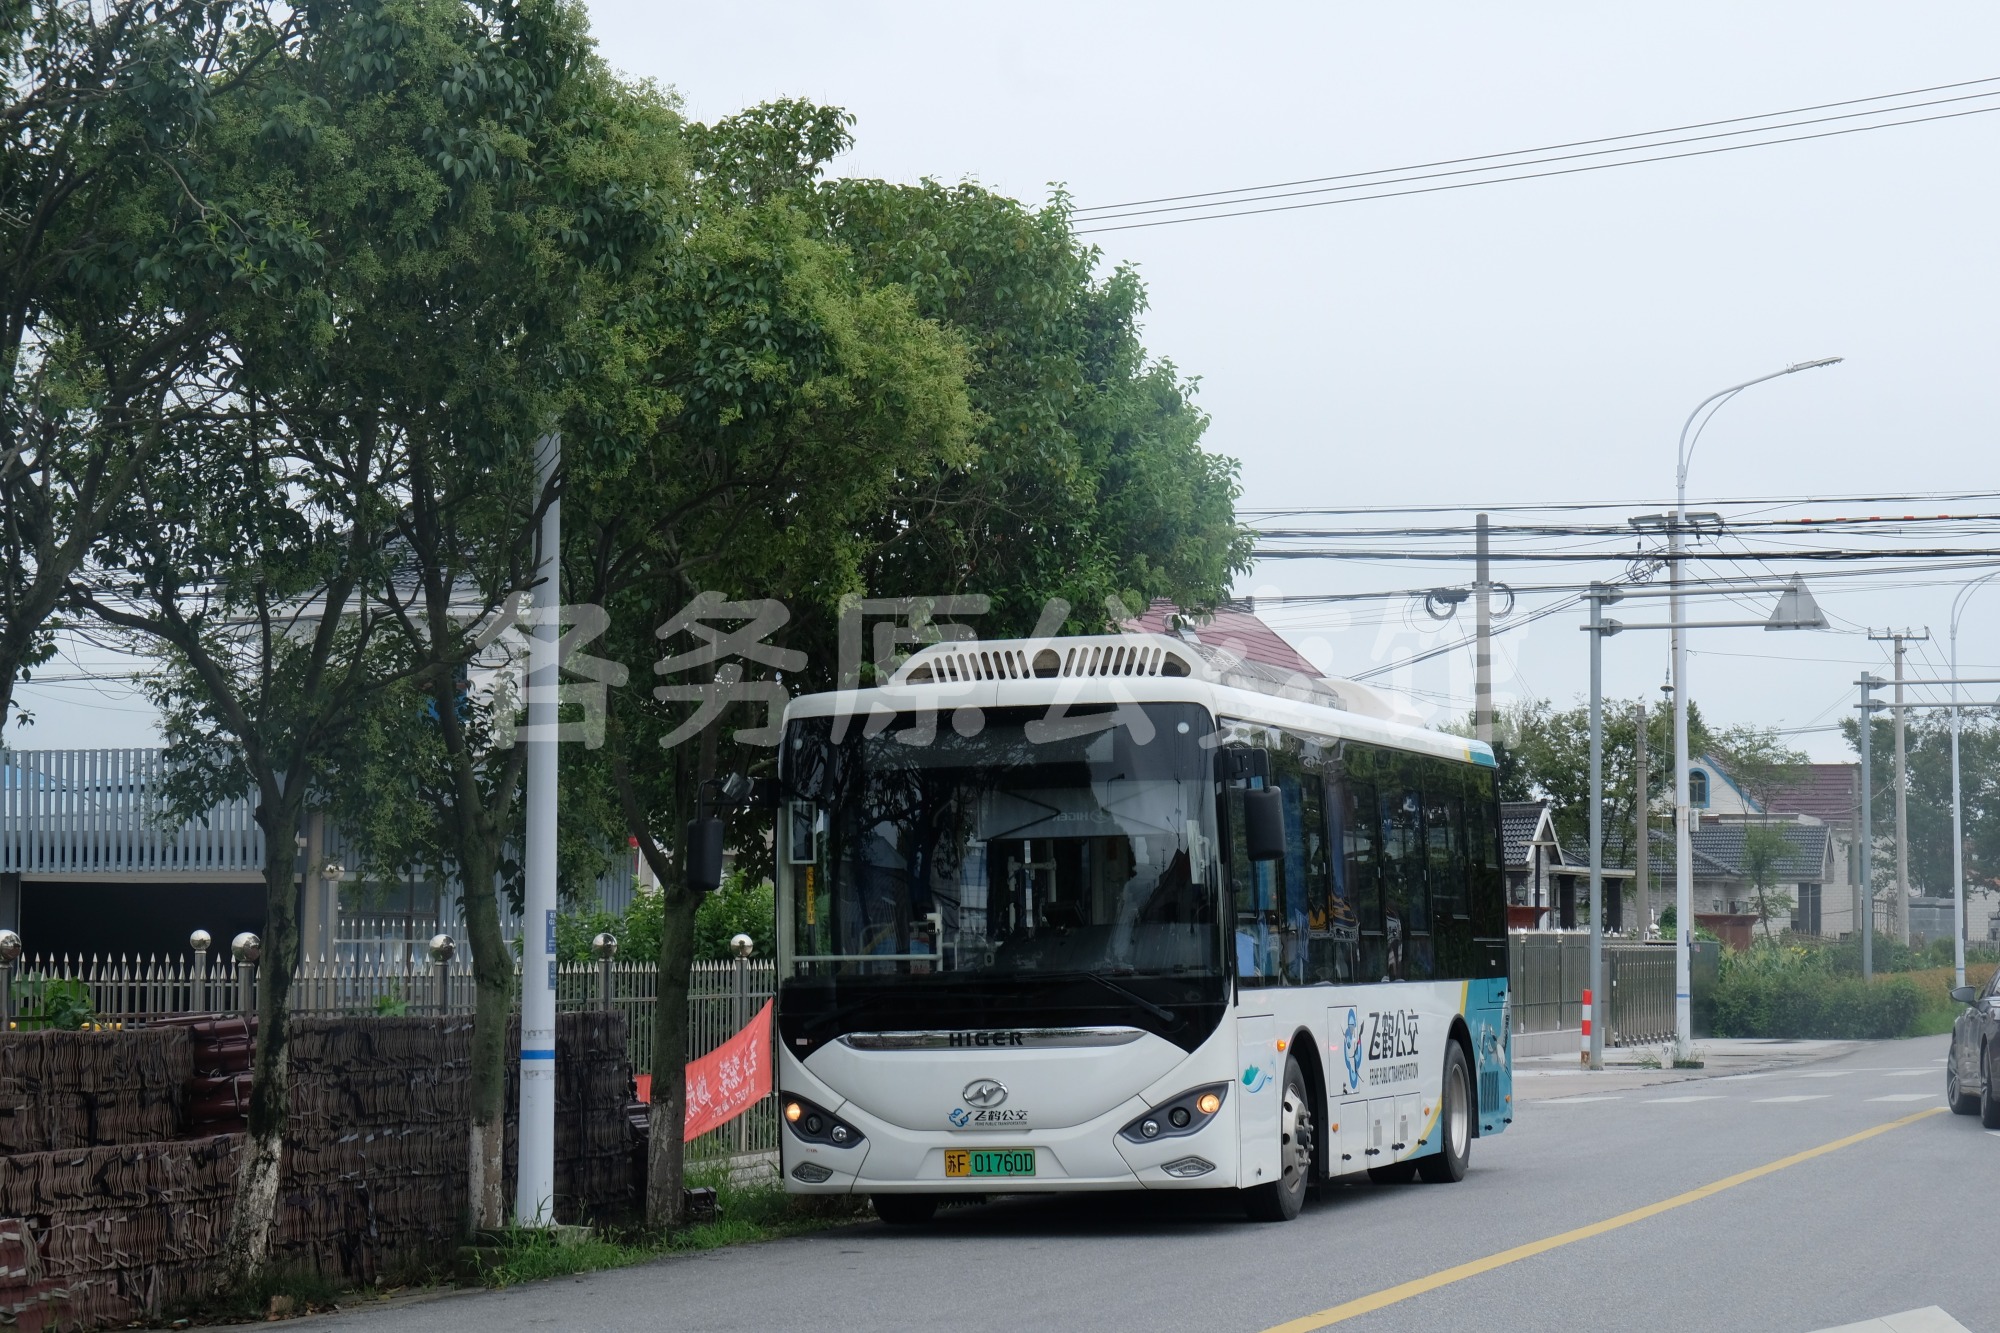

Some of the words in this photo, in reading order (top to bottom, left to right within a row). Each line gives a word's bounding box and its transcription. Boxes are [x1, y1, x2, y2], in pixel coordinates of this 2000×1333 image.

[949, 1032, 1023, 1047] HIGER
[1368, 1008, 1419, 1060] 飞鹤公交
[974, 1109, 1029, 1121] 飞鹤公交
